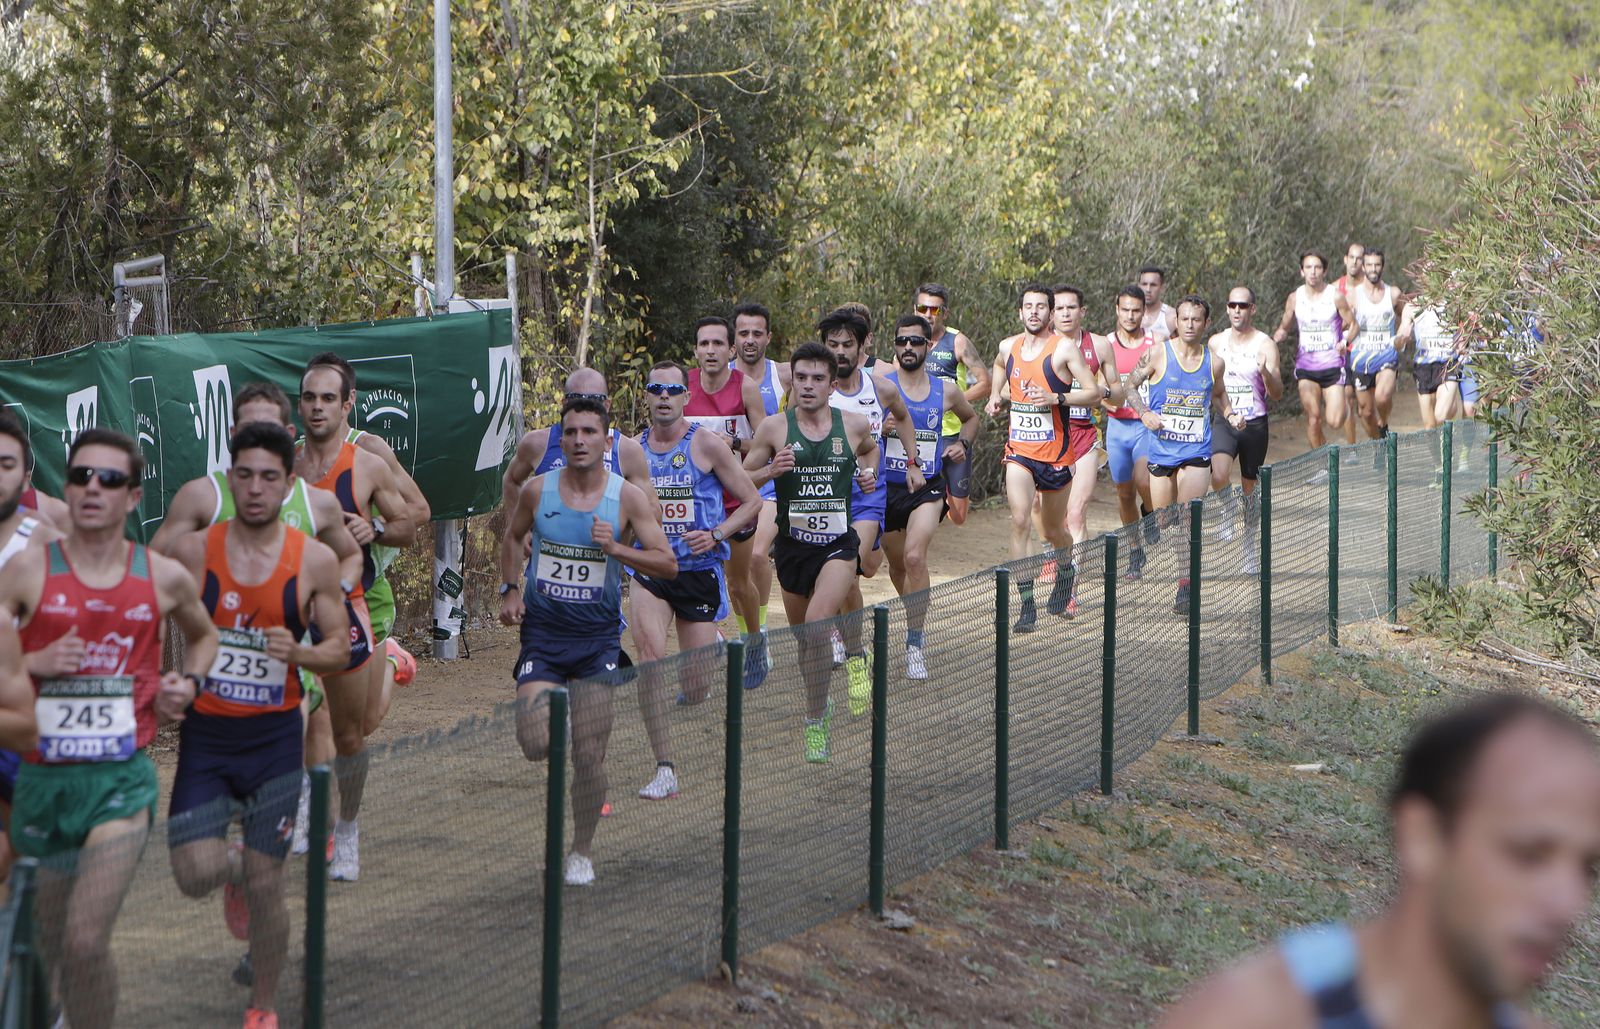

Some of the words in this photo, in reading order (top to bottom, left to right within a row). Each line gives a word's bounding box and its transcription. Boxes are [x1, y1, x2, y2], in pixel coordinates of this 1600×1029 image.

[362, 389, 409, 413] DIPUTACION
[383, 419, 391, 429] DE
[1018, 415, 1042, 428] 230
[1172, 418, 1194, 431] 167
[793, 464, 840, 473] FLORISTERÍA
[798, 484, 834, 496] JACA
[807, 516, 829, 530] 85
[551, 562, 590, 582] 219
[542, 583, 593, 600] Joma
[219, 652, 269, 679] 235
[519, 661, 533, 677] AB
[57, 704, 114, 729] 245
[46, 736, 122, 759] Joma
